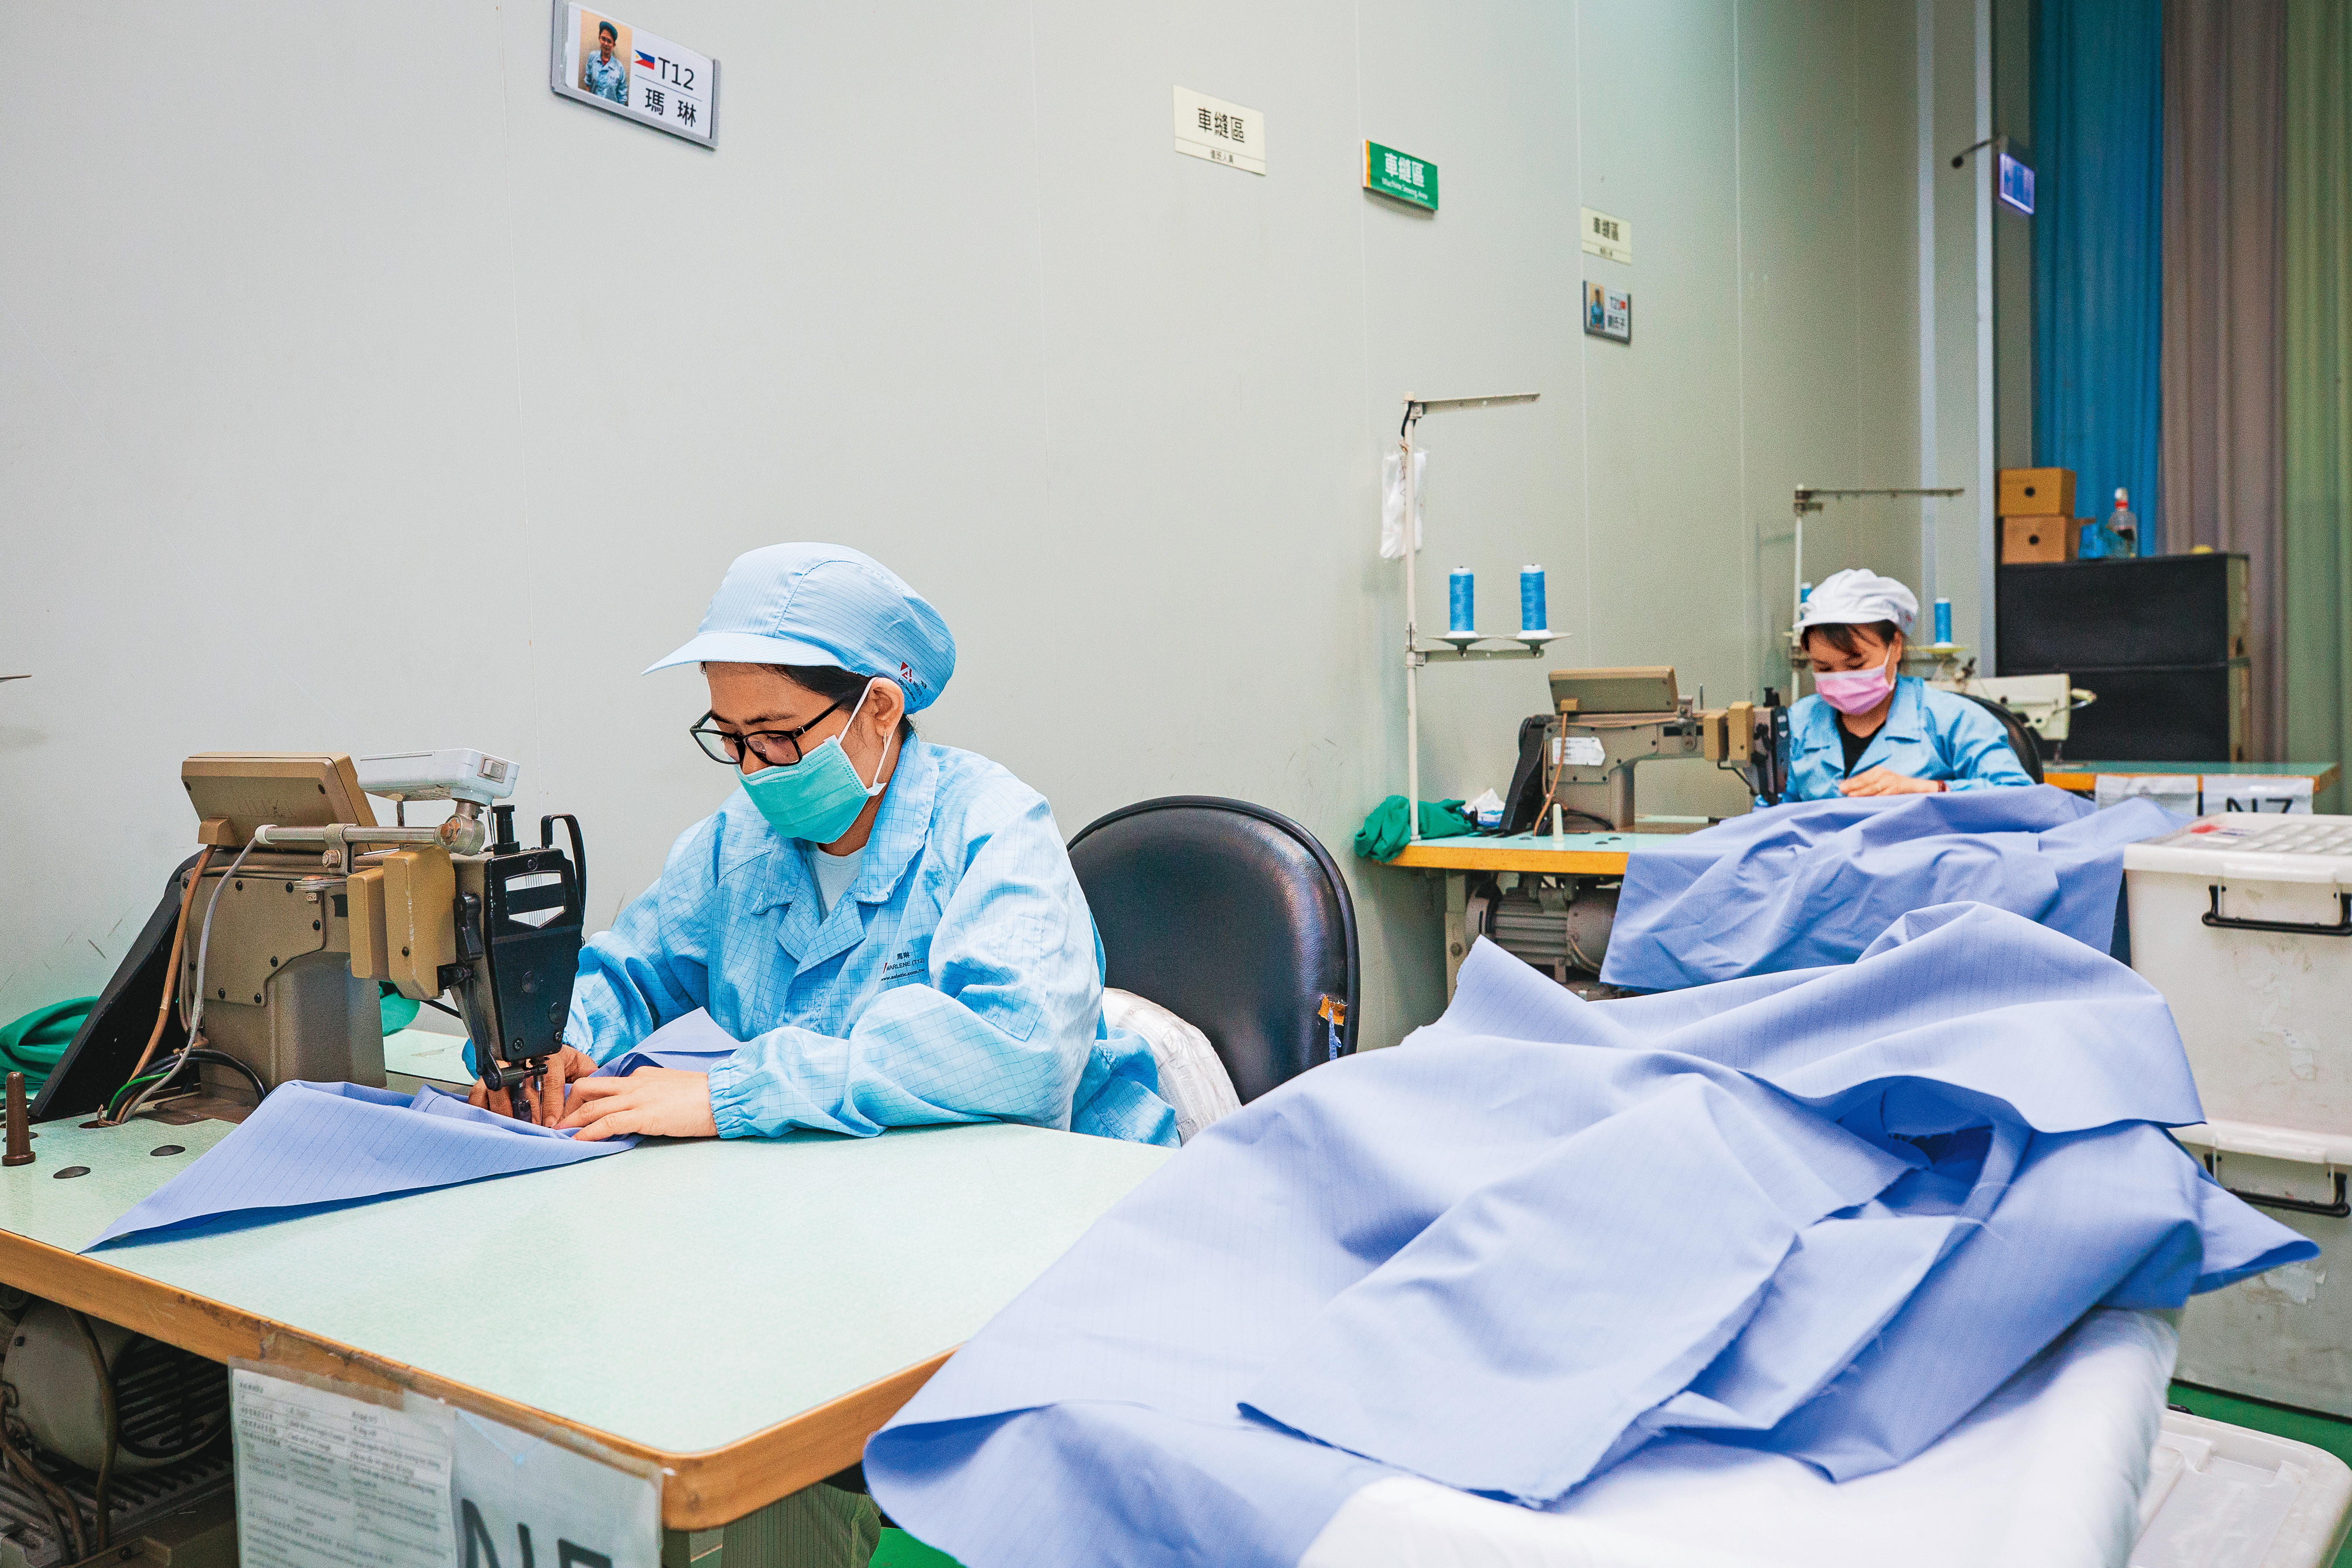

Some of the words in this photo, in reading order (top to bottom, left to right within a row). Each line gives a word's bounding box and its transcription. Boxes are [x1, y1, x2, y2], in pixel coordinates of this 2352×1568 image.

[658, 57, 694, 91] T12
[644, 87, 696, 128] 瑪琳
[1198, 107, 1245, 143] 車縫區
[1384, 152, 1425, 188] 車縫區
[912, 958, 925, 966] (T12)
